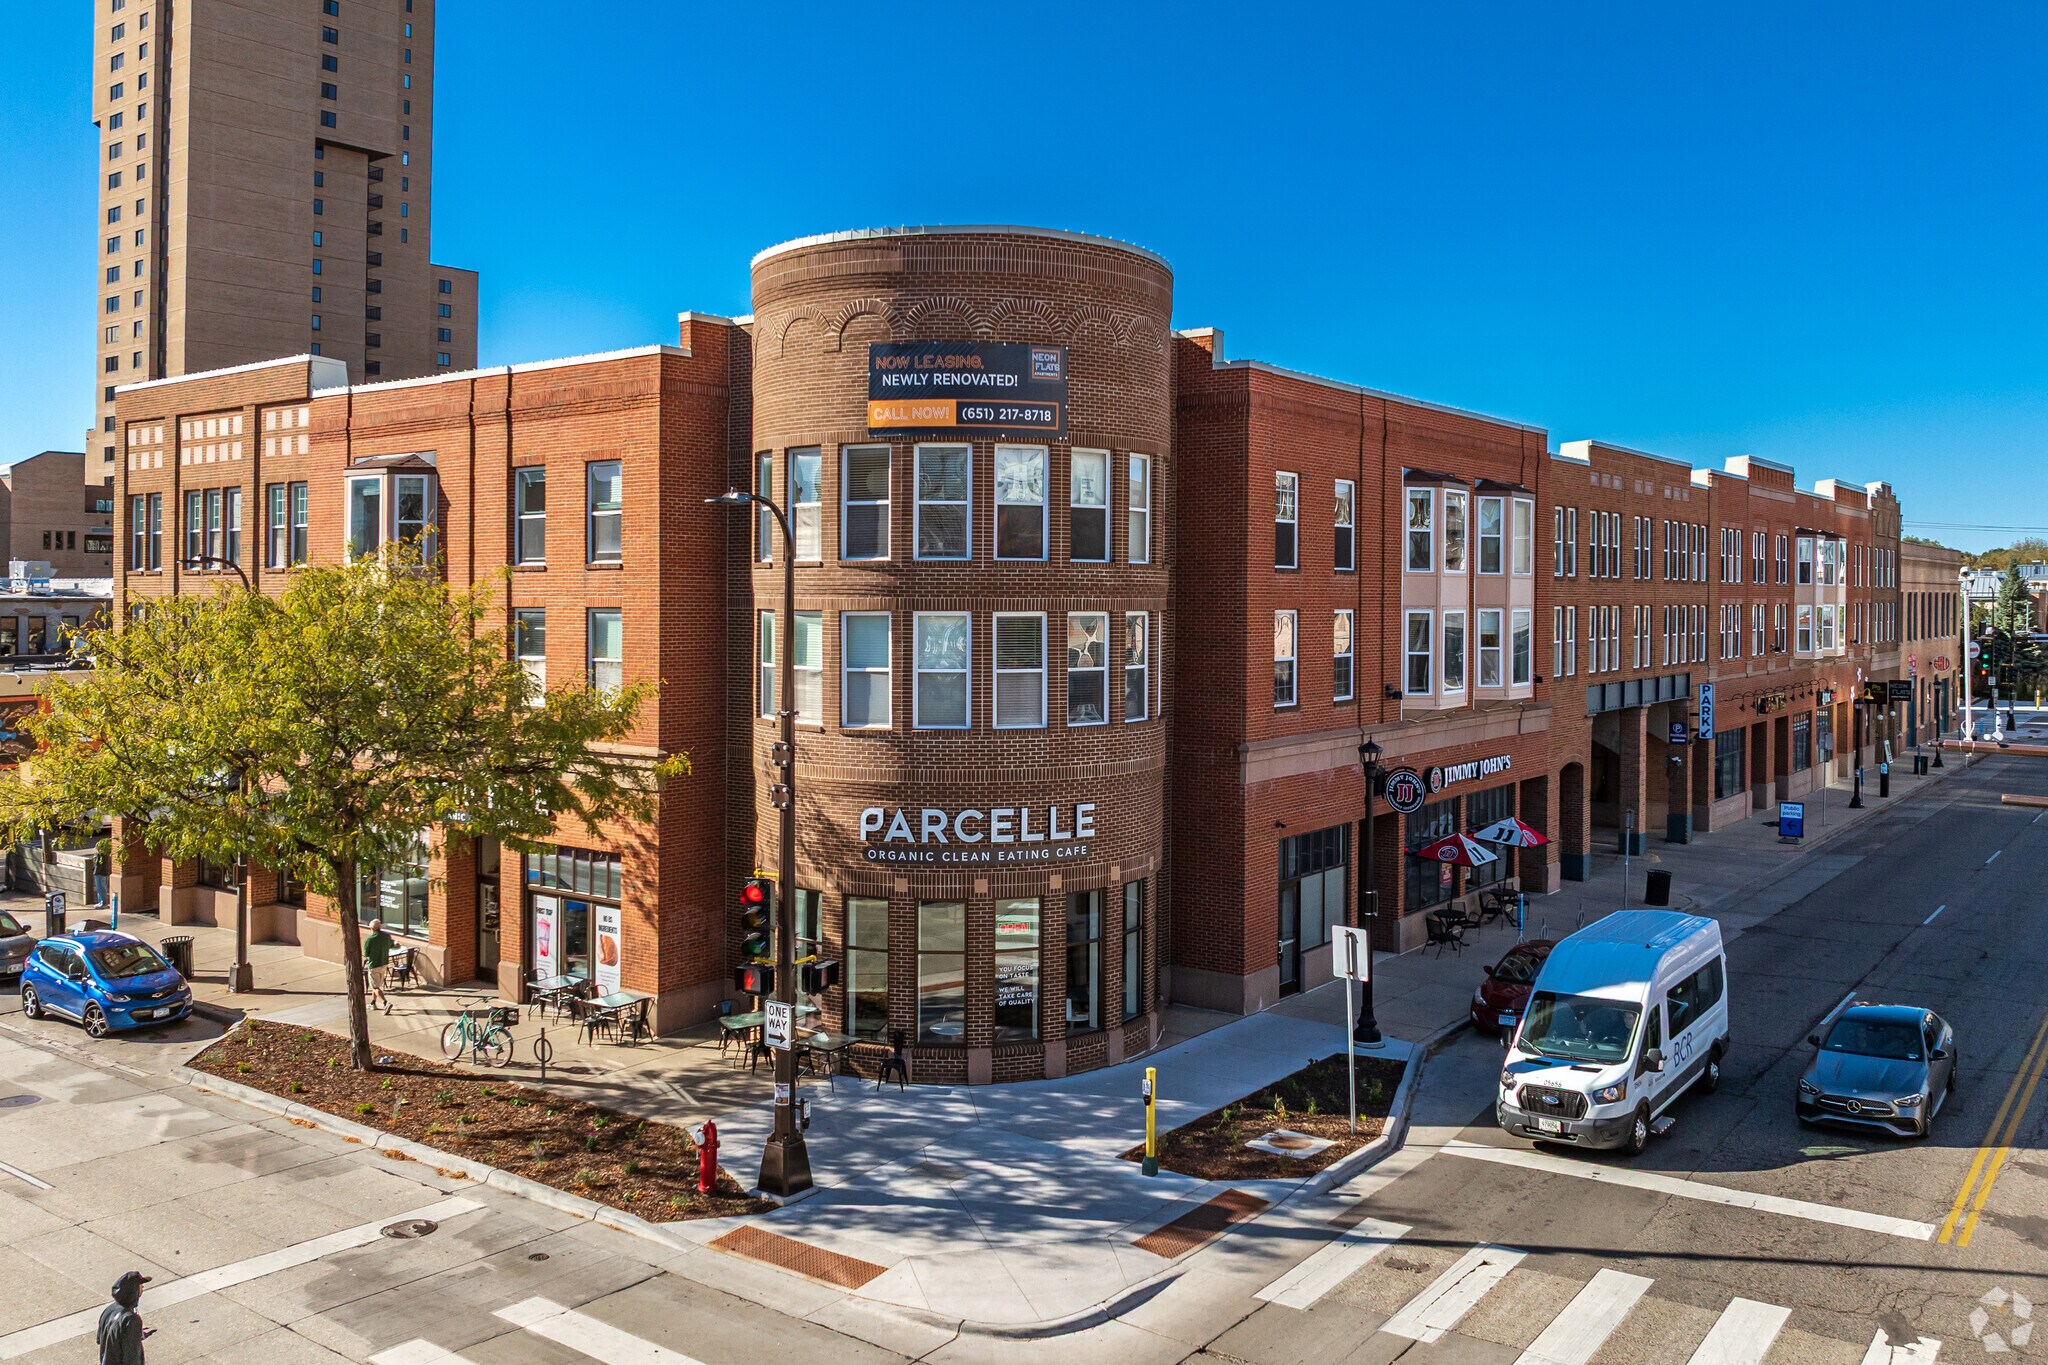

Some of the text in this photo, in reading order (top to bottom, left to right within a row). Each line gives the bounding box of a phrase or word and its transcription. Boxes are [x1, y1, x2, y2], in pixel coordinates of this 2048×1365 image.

[875, 354, 985, 370] NOW LEASING.
[1031, 352, 1057, 362] NEON
[882, 373, 1018, 387] NEWLY RENOVATED!
[873, 406, 949, 420] CALL NOW!
[962, 407, 1052, 422] (651) 217-8718
[1701, 685, 1712, 727] PARK
[1444, 761, 1479, 789] JIMMY
[1479, 755, 1511, 780] JOHN'S
[1396, 783, 1414, 803] JJ
[859, 803, 1096, 844] PARCELLE
[1492, 827, 1515, 843] JJ
[867, 845, 1088, 862] ORGANIC CLEAN EATING CAFE
[999, 922, 1029, 935] OPEN
[1010, 971, 1029, 979] TASTE
[1008, 998, 1035, 1006] QUALITY
[768, 1005, 788, 1019] ONE
[768, 1017, 788, 1031] WAY
[1673, 1032, 1693, 1068] BCR
